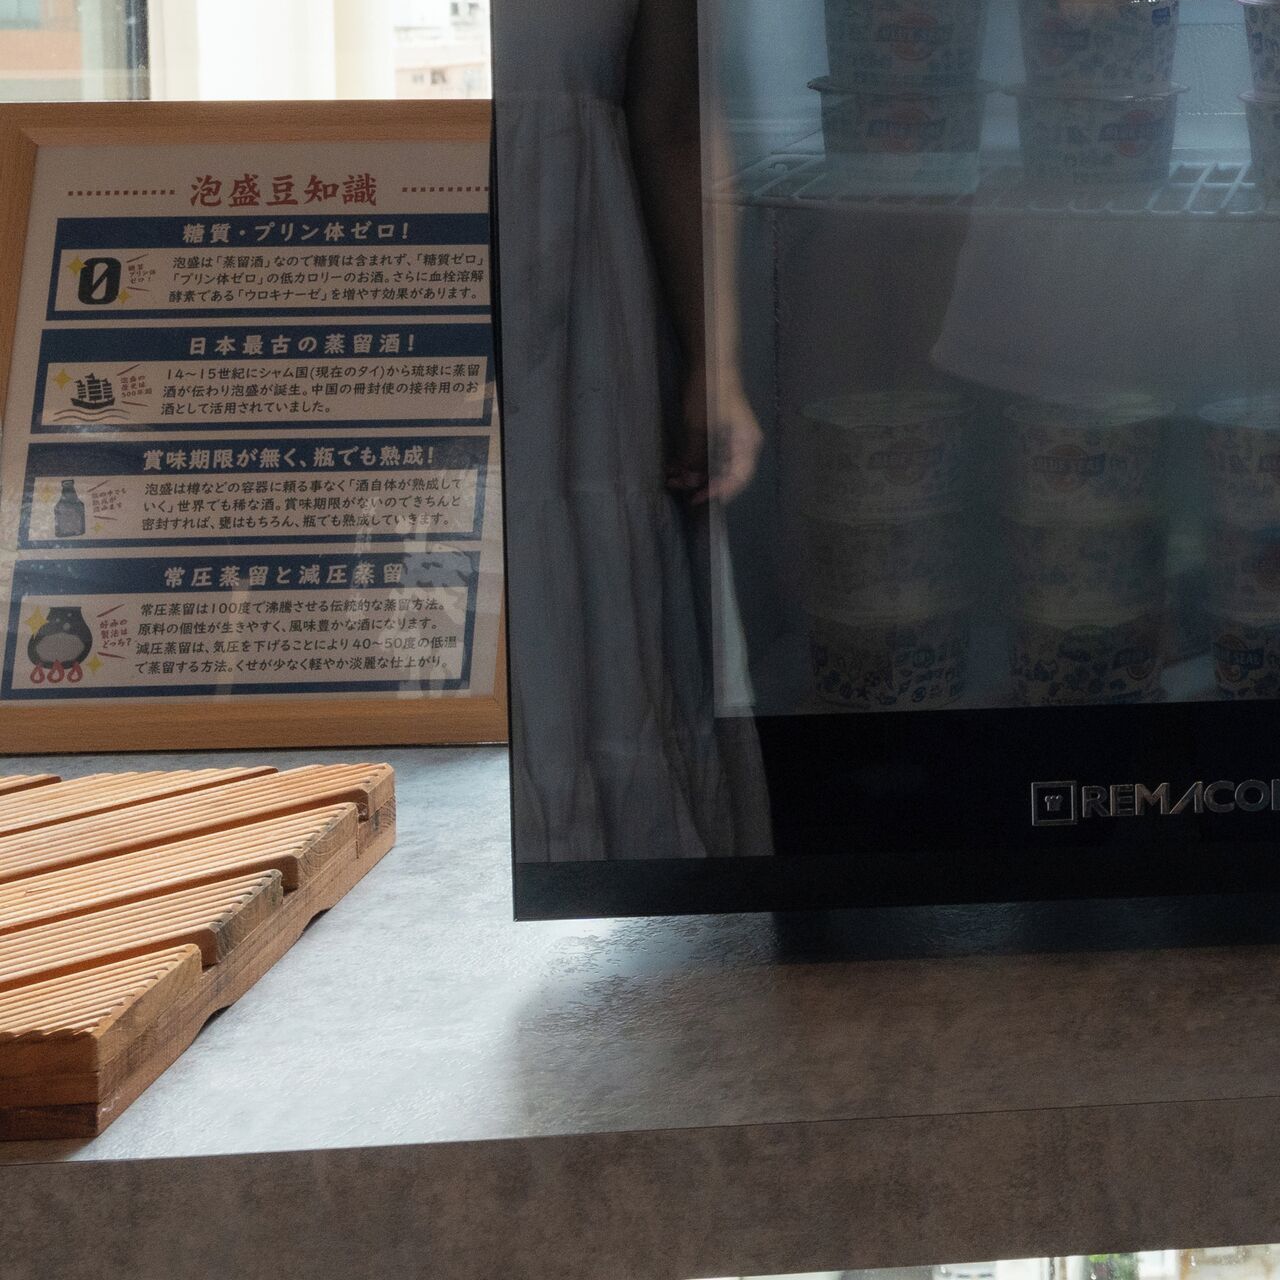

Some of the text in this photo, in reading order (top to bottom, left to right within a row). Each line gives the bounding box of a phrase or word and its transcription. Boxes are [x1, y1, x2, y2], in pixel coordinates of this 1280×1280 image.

[190, 173, 378, 208] 泡盛豆知識
[182, 222, 409, 243] 糖質・プリン体ゼロ!
[189, 333, 416, 356] 日本最古の蒸留酒!
[160, 400, 331, 416] 酒として活用されていました。
[143, 446, 436, 471] 賞味期限が無く、瓶でも熟成!
[164, 563, 402, 588] 常圧蒸留と減圧蒸留
